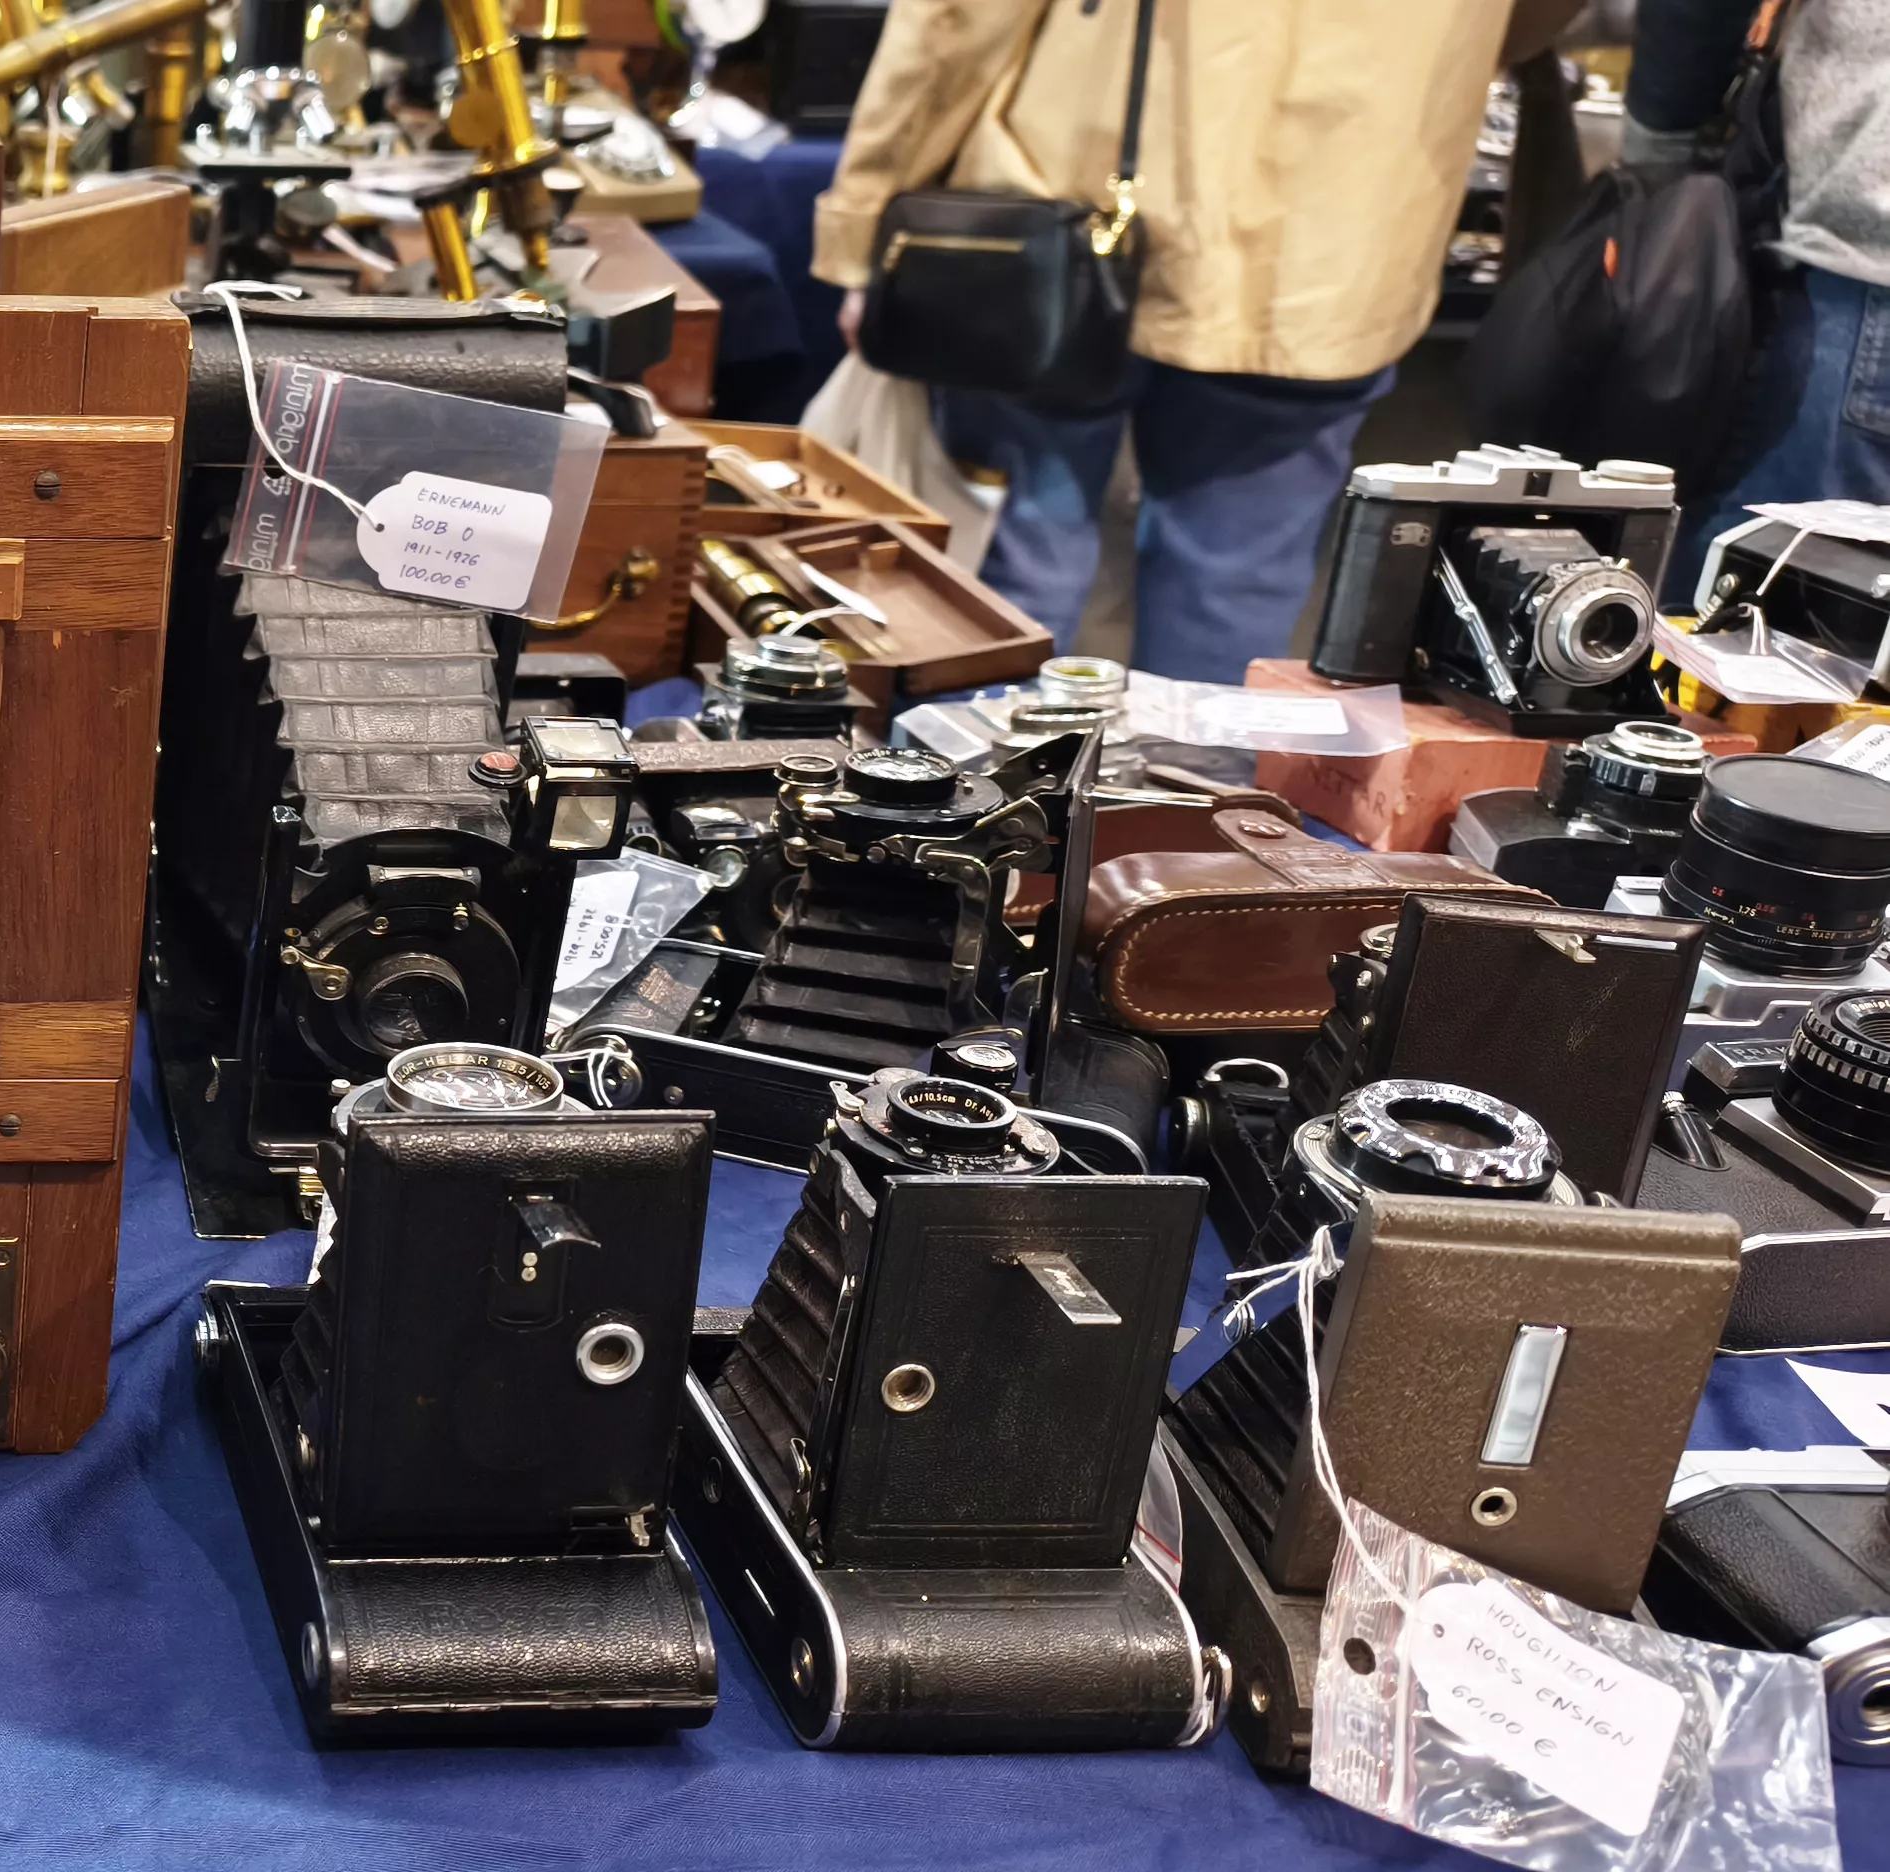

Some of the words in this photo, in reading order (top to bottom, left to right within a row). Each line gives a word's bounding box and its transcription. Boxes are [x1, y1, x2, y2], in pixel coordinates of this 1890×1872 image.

[416, 487, 506, 516] ERNEMANN
[411, 514, 449, 535] BOB
[1776, 925, 1802, 938] LENS
[1811, 931, 1836, 942] MADE
[1486, 1602, 1618, 1693] HOUGHTON
[1466, 1635, 1523, 1685] ROSS
[1536, 1686, 1634, 1747] ENSIGN
